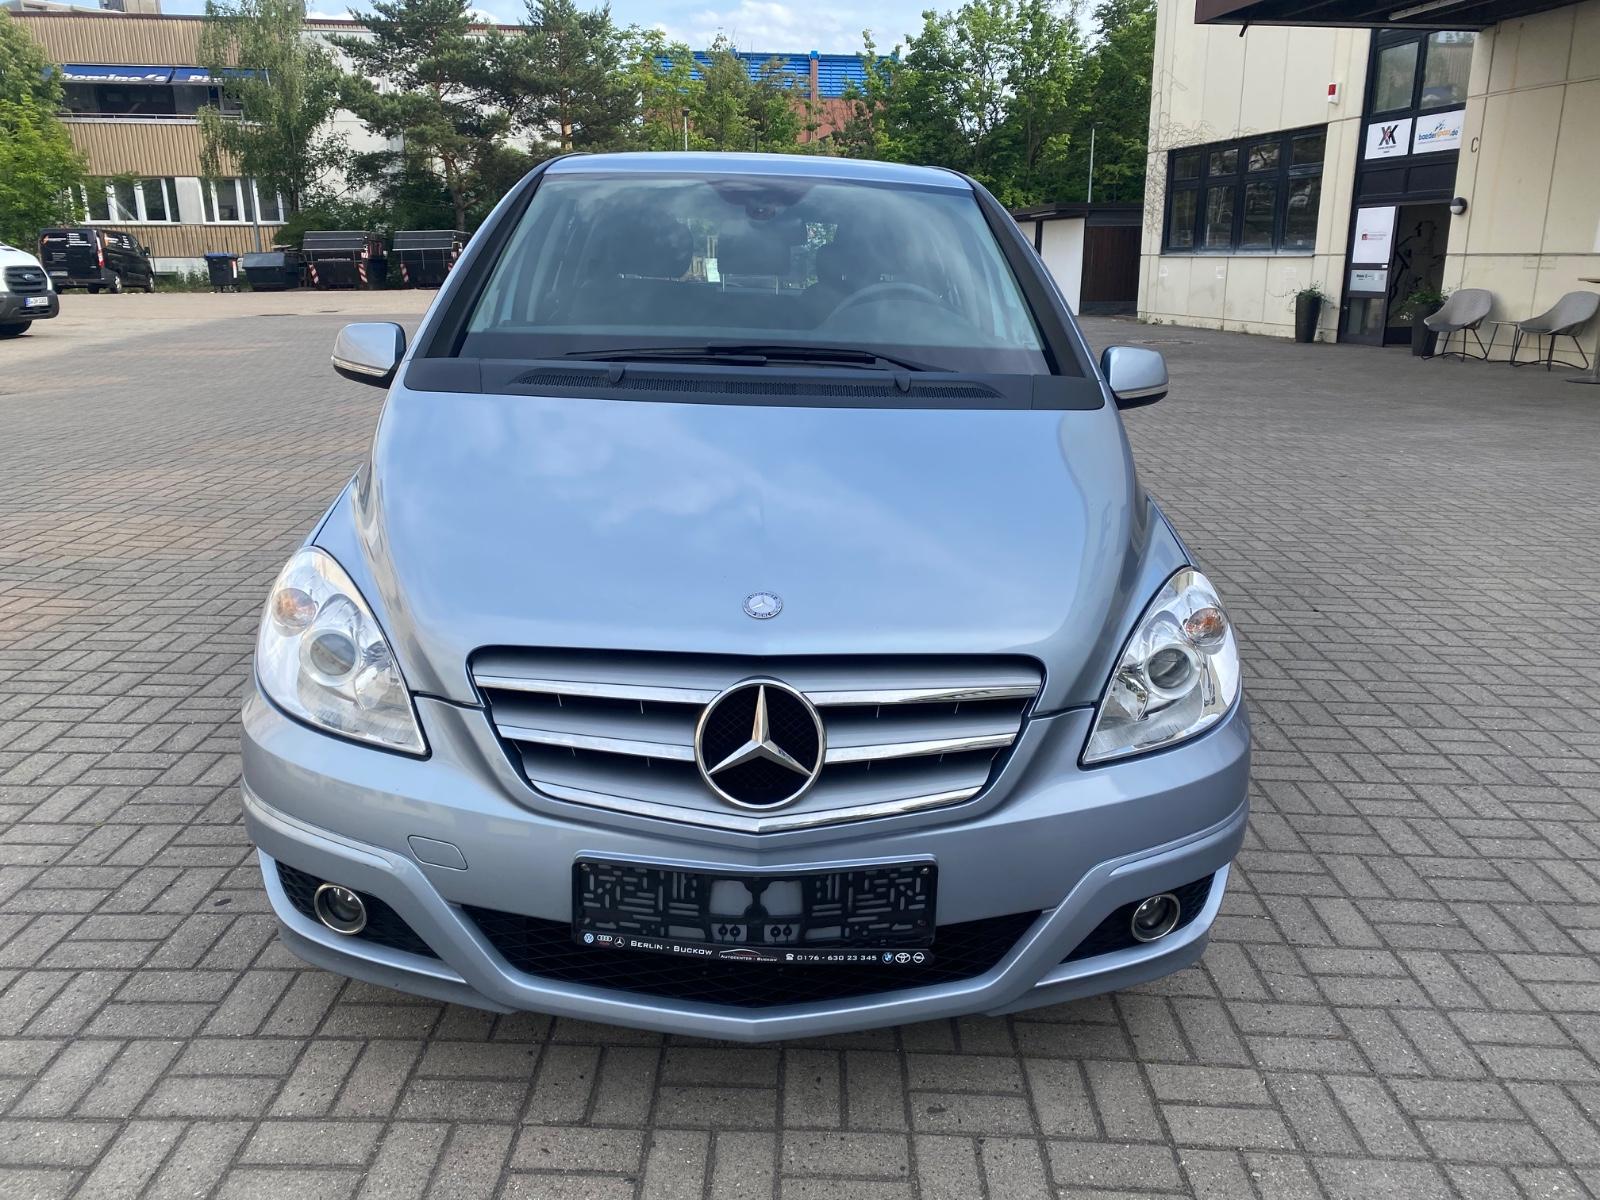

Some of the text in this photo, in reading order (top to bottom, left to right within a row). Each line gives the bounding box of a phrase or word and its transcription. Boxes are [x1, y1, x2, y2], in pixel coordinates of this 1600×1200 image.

[1471, 137, 1479, 153] C
[630, 940, 663, 950] BERLIN
[673, 945, 713, 956] BUCKOW
